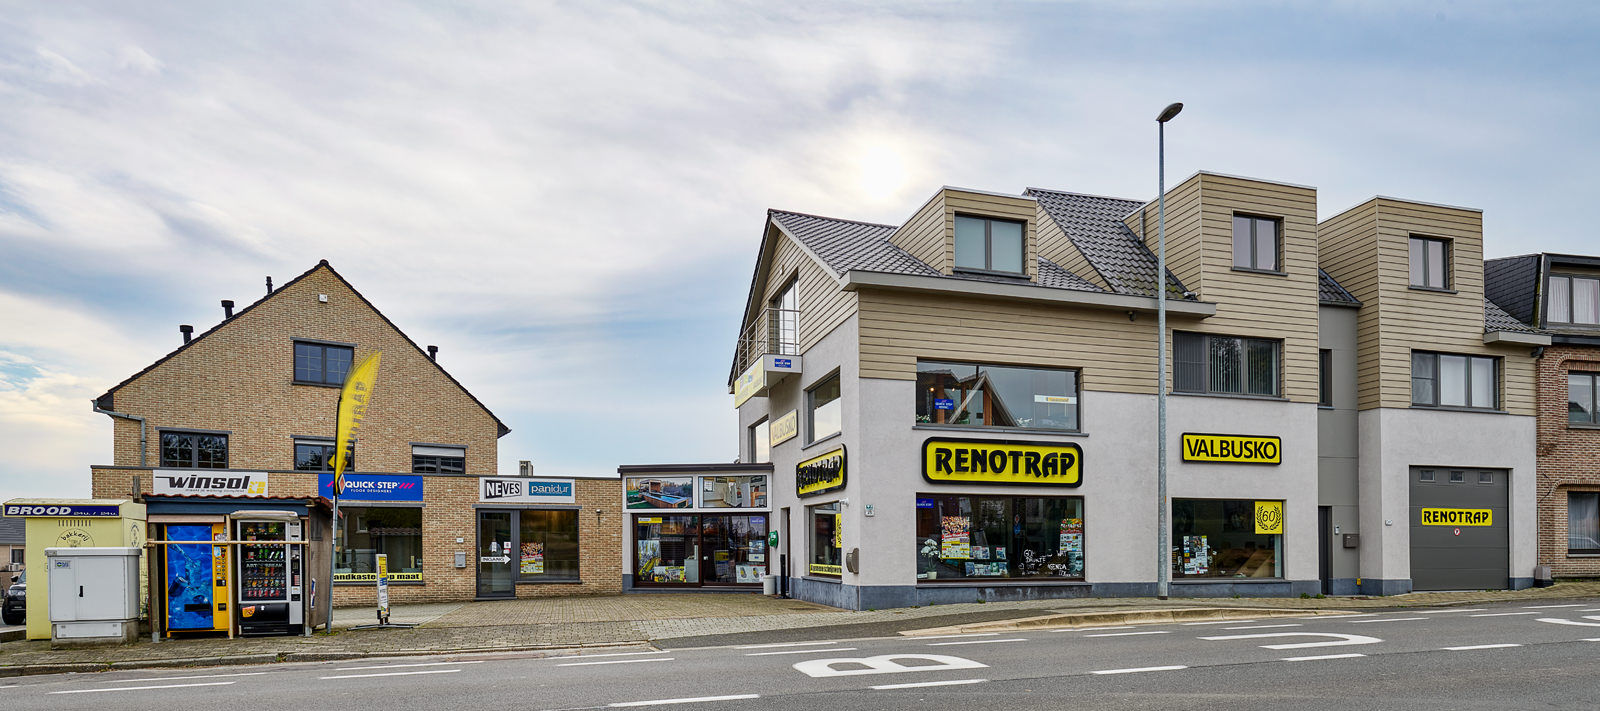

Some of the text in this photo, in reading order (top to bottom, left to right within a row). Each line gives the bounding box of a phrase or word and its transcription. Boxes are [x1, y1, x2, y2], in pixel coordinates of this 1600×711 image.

[1186, 438, 1277, 459] VALBUSKO
[935, 447, 1075, 478] RENOTRAP
[155, 474, 250, 489] winsol
[345, 481, 398, 489] QUICK STEP
[486, 482, 569, 497] NEVES panidur
[7, 506, 72, 515] BROOD
[1262, 510, 1276, 522] 60
[1423, 510, 1489, 524] RENOTRAP
